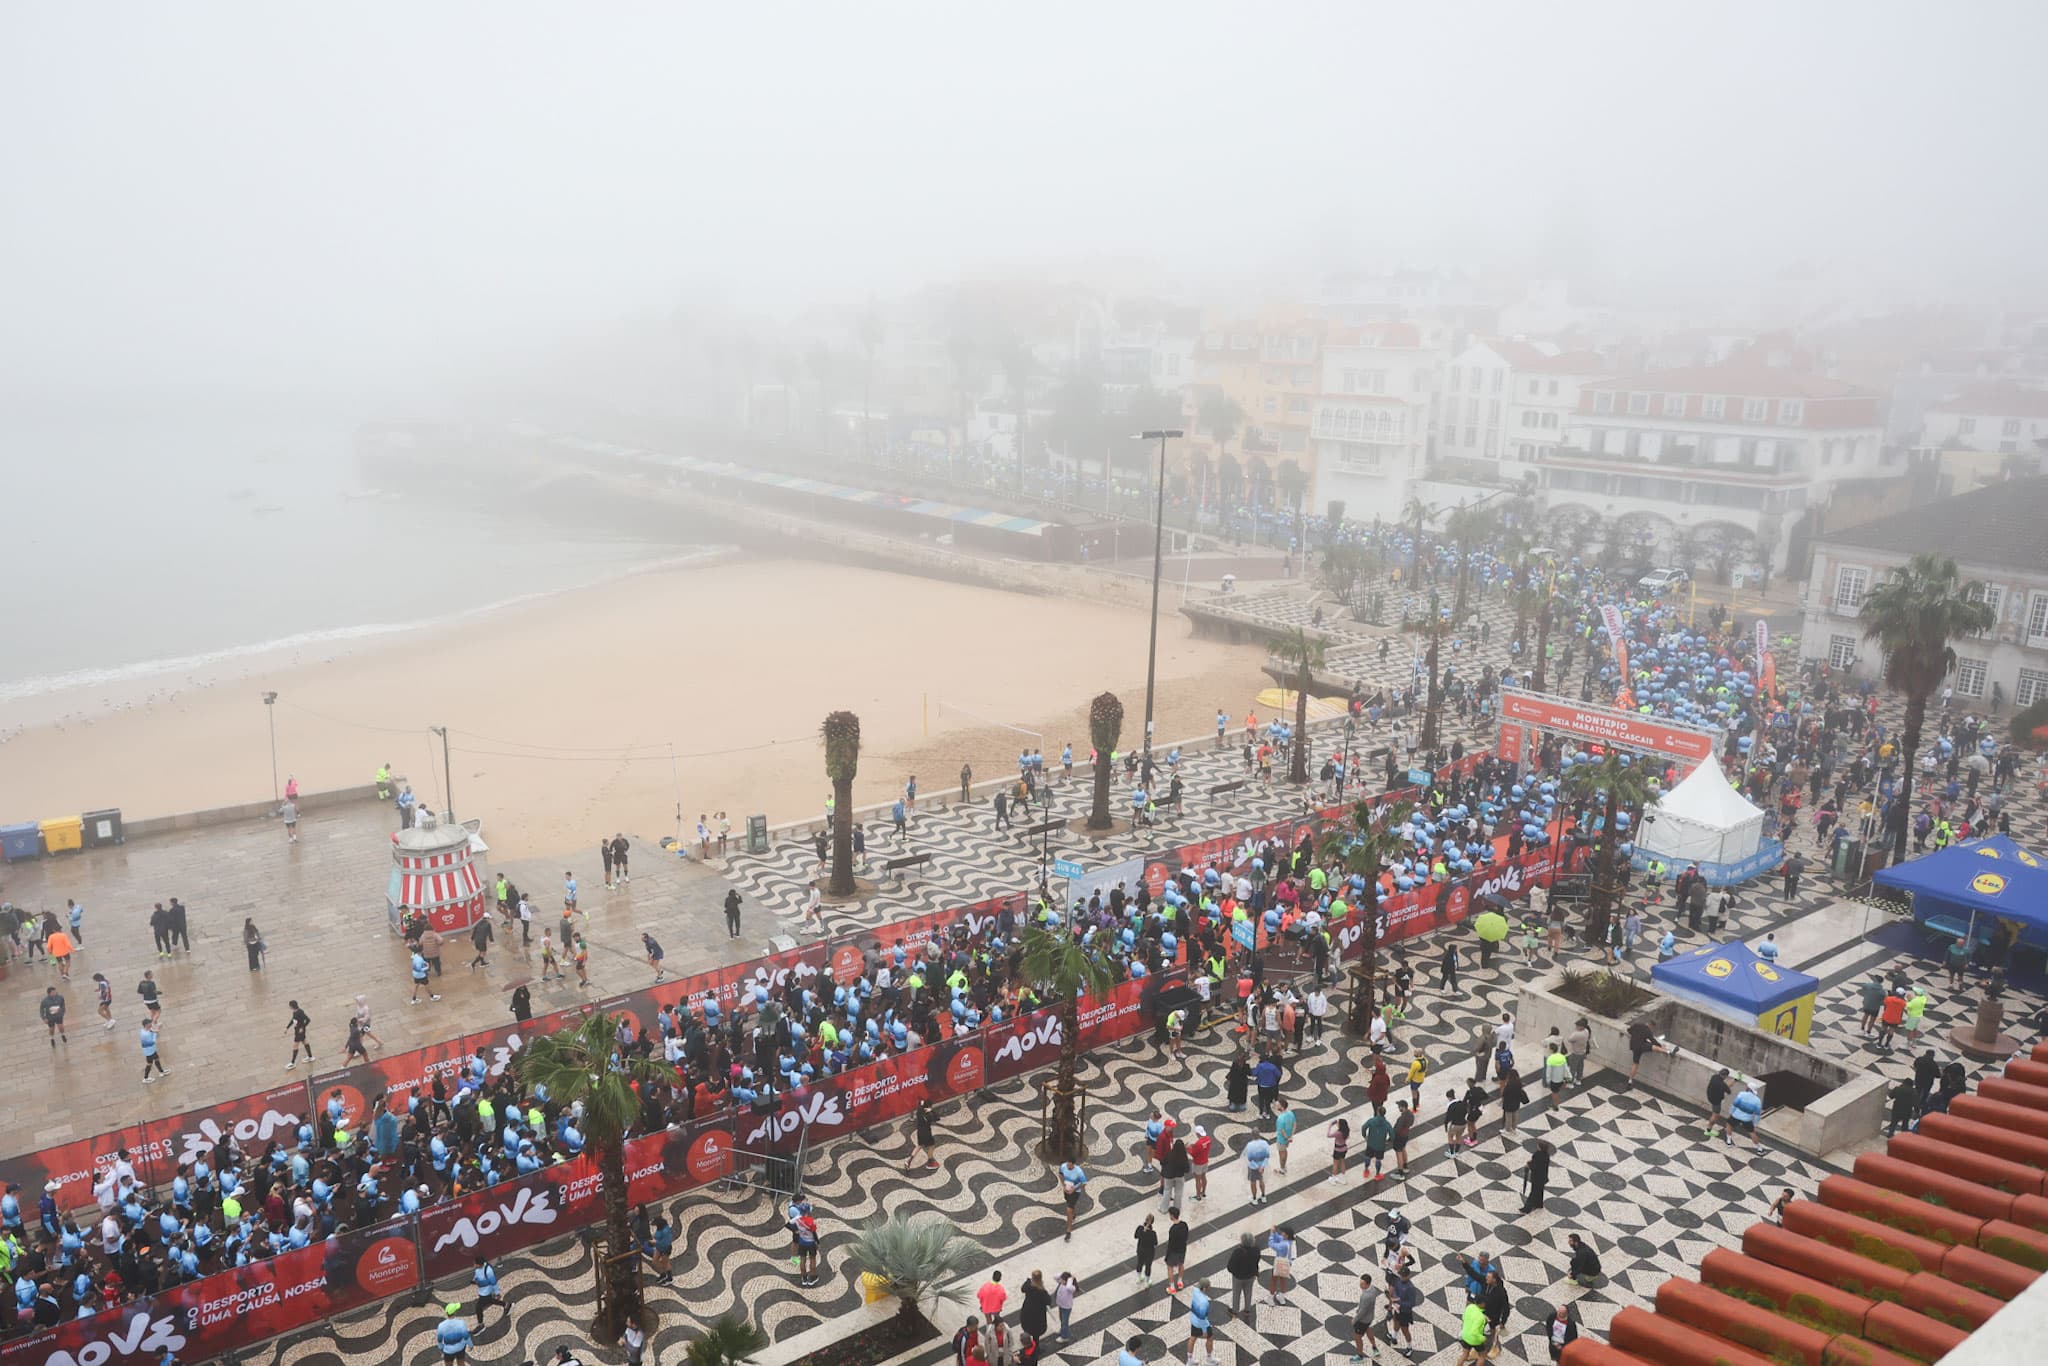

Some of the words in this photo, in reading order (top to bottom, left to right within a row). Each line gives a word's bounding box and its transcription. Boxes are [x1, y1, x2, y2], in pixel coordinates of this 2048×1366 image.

[1550, 716, 1570, 727] MEIA
[1572, 721, 1617, 737] MARATONA
[1619, 731, 1654, 745] CASCAIS
[1576, 712, 1628, 731] MONTEPIO
[1472, 865, 1521, 900] MOVE
[1081, 1002, 1117, 1020] DESPORTO
[1095, 1009, 1118, 1024] CAUSA
[1118, 1003, 1142, 1016] NOSSA
[845, 1090, 853, 1100] O
[853, 1074, 897, 1097] DESPORTO
[853, 1093, 872, 1107] UMA
[873, 1084, 900, 1100] CAUSA
[902, 1073, 929, 1089] NOSSA
[746, 1091, 844, 1144] MOVE
[695, 1152, 727, 1169] Montepo
[558, 1184, 568, 1195] O
[569, 1173, 605, 1192] DESPO
[569, 1189, 592, 1203] UMA
[631, 1161, 665, 1181] NOSSA
[433, 1187, 557, 1253] MOVE
[368, 1262, 409, 1281] Montepio
[187, 1306, 199, 1318] O
[202, 1282, 275, 1314] DESPORTO
[201, 1309, 232, 1326] UMA
[235, 1293, 281, 1315] CAUSA
[284, 1276, 328, 1299] NOSSA
[1, 1332, 57, 1356] montepio.org
